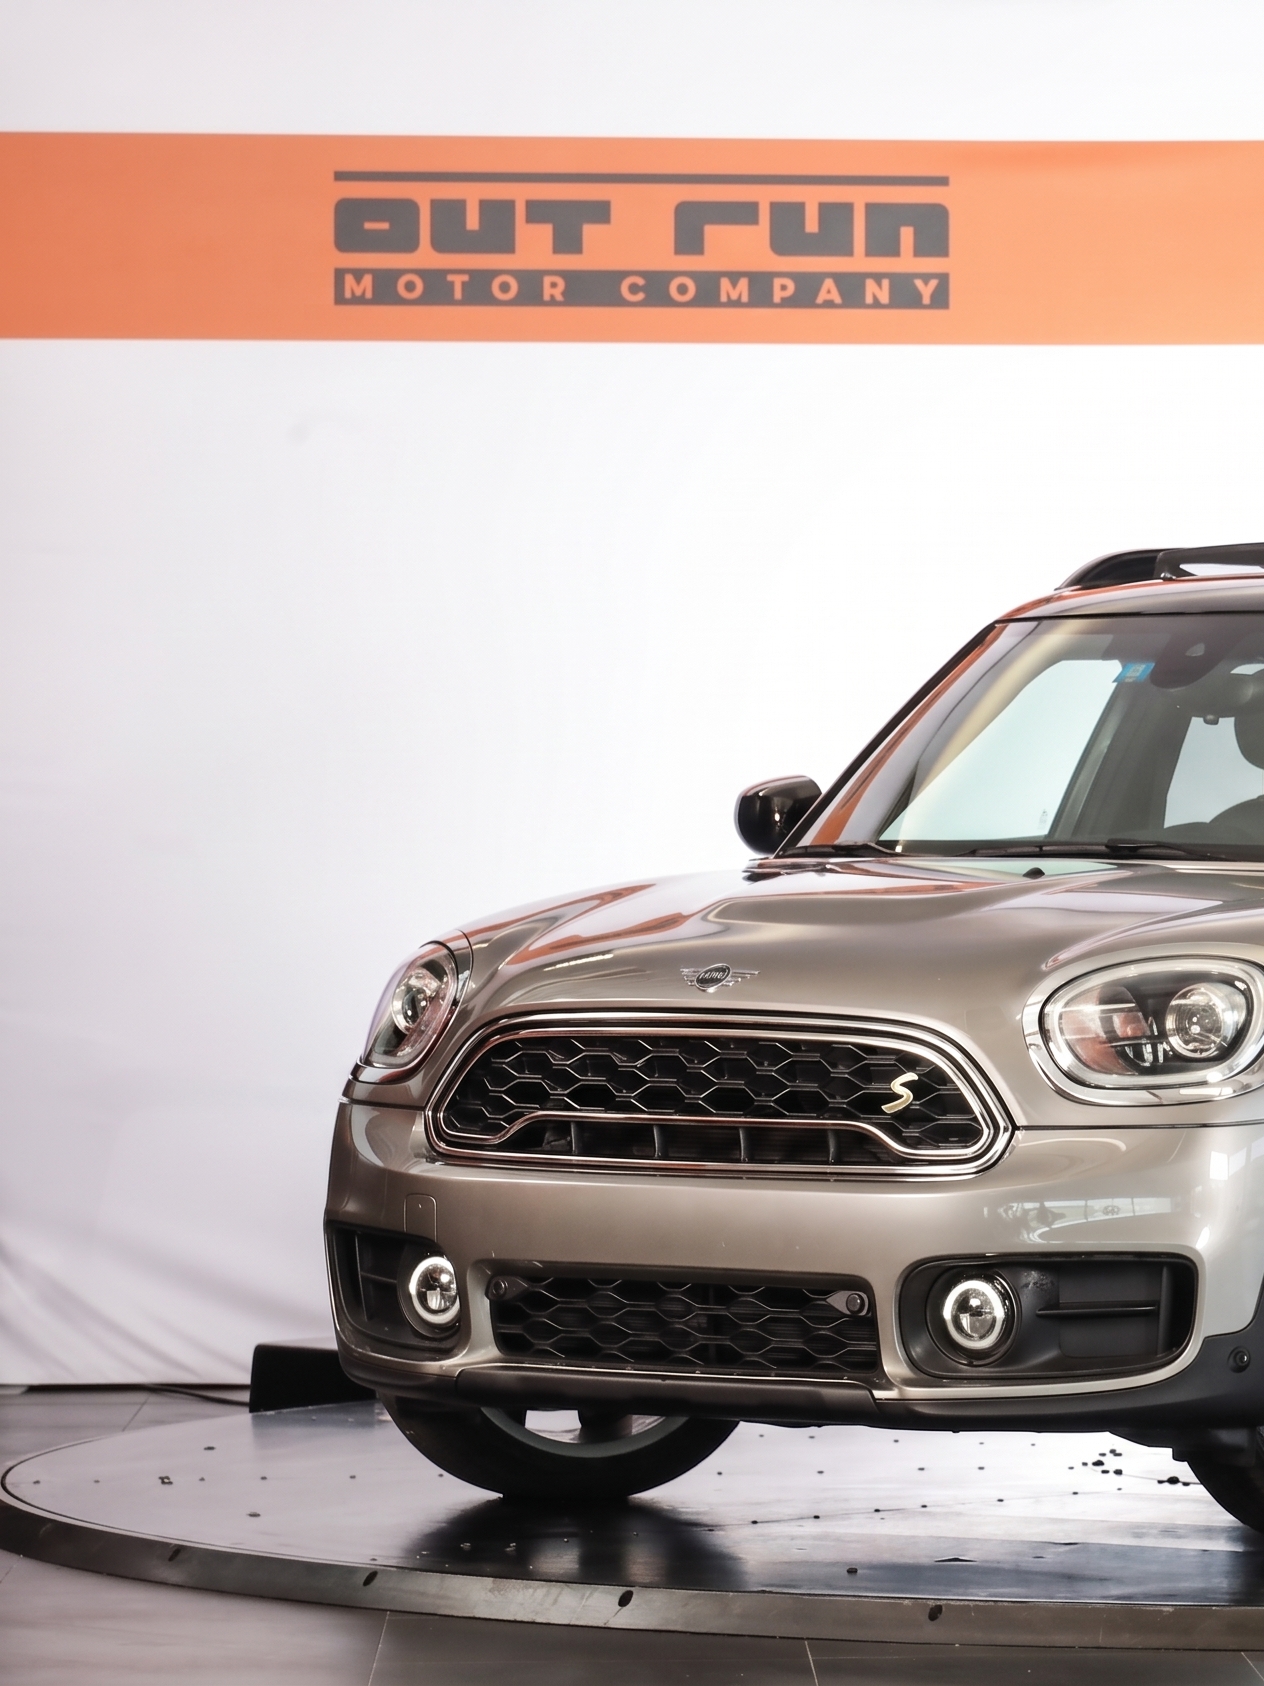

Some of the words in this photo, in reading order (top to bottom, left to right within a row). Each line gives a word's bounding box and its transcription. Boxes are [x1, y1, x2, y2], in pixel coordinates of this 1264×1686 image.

[344, 273, 565, 302] MOTOR
[620, 275, 939, 304] COMPANY
[881, 1072, 919, 1114] S
